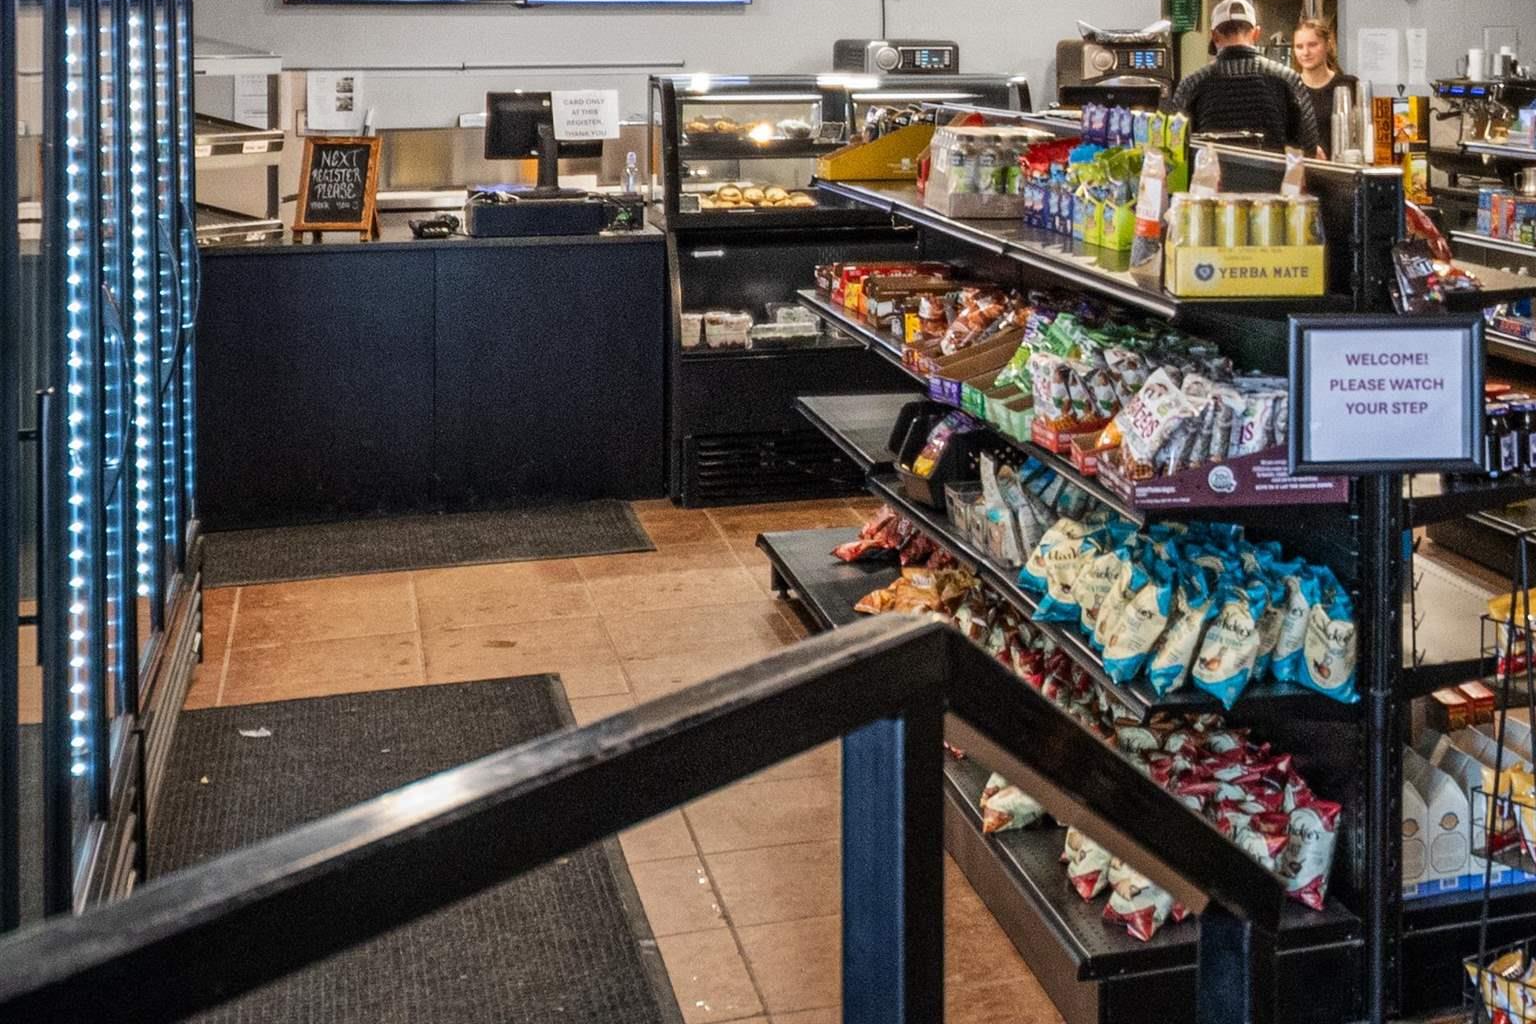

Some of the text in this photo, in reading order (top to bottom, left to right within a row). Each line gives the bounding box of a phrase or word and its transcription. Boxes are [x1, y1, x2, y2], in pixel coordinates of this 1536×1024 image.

[321, 149, 364, 167] NEXT
[312, 167, 361, 183] REGISTER
[315, 182, 356, 200] PLEASE
[1218, 265, 1309, 279] YERBA MATE
[1345, 353, 1429, 366] WELCOME!
[1329, 378, 1444, 392] PLEASE WATCH
[1346, 401, 1429, 415] YOUR STEP
